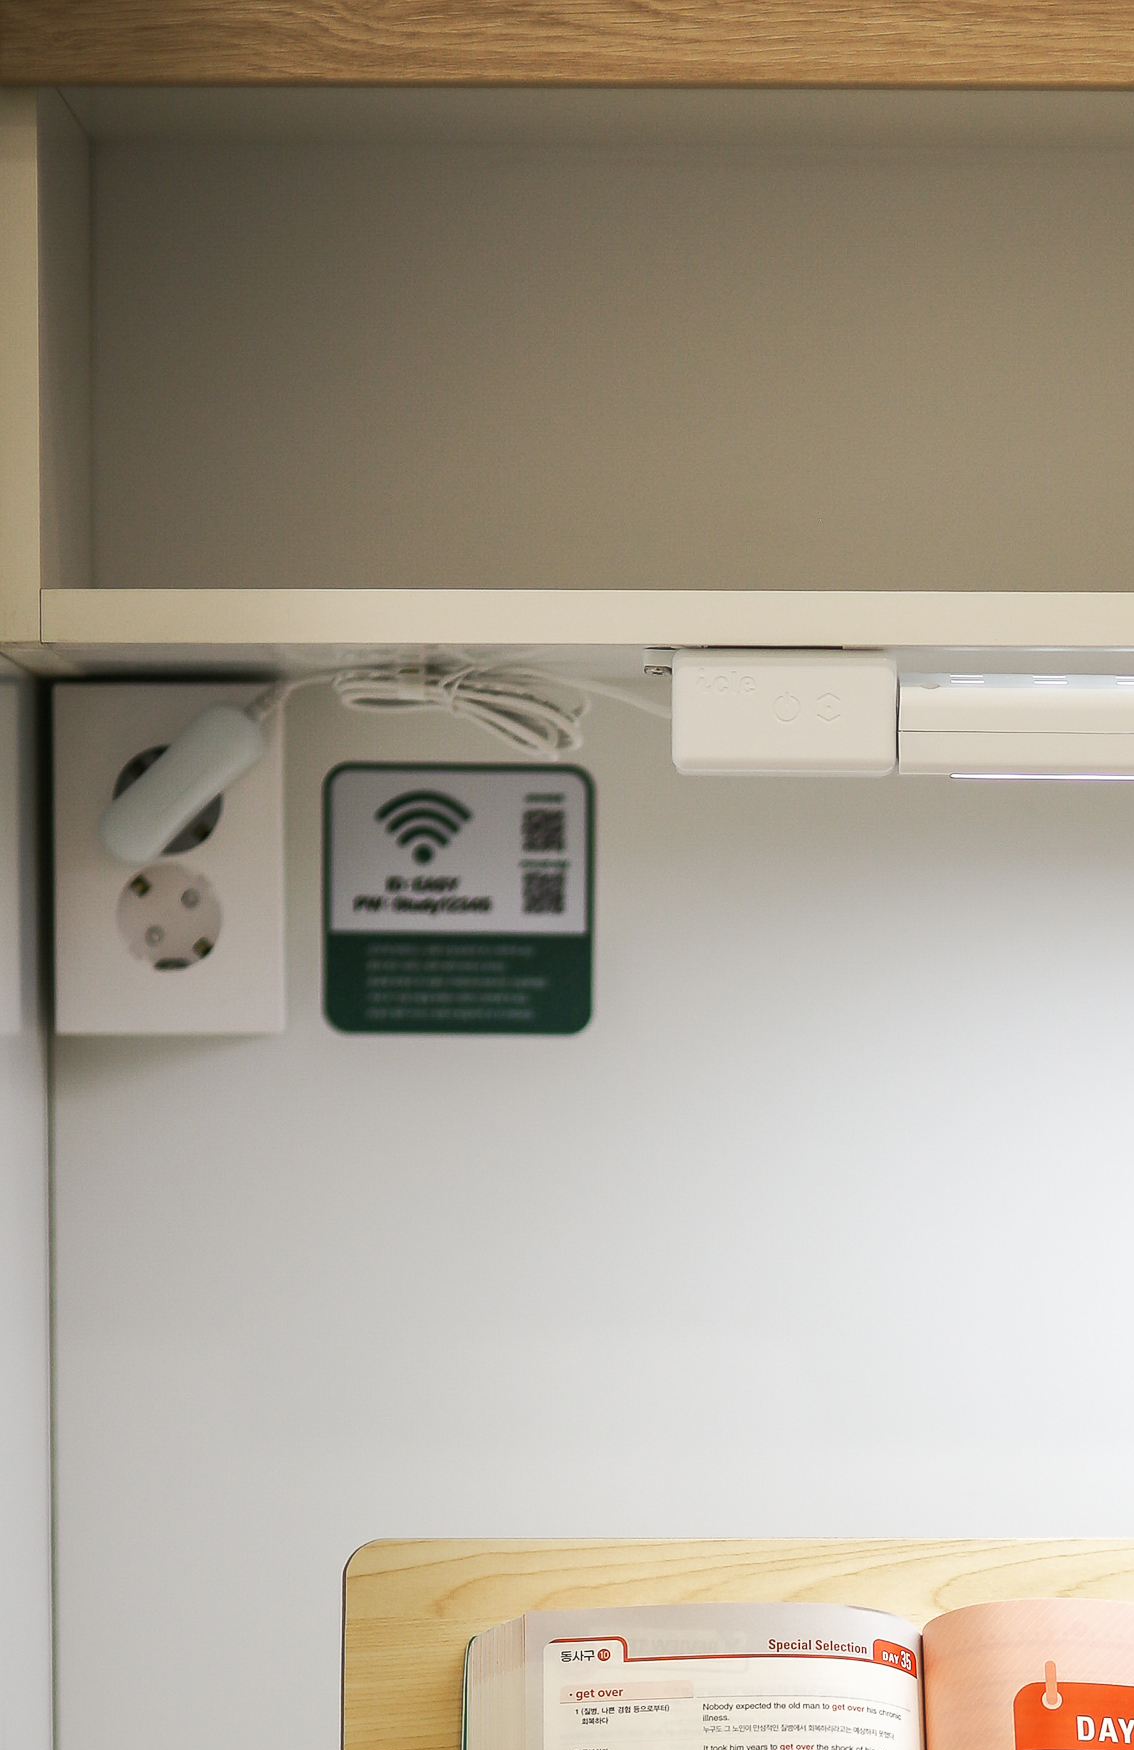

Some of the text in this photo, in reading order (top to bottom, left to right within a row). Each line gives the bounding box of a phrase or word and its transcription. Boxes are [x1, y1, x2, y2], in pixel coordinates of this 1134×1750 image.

[768, 1639, 868, 1654] Special Selection
[560, 1649, 610, 1663] 동사구 10
[882, 1650, 912, 1671] DAY 35
[576, 1689, 624, 1701] get over
[601, 1706, 615, 1715] 나쁜
[617, 1705, 631, 1714] 경험
[702, 1703, 733, 1711] Nobody
[735, 1702, 772, 1711] expected
[773, 1702, 786, 1710] the
[831, 1704, 845, 1712] get
[847, 1704, 865, 1712] over
[866, 1706, 877, 1715] his
[878, 1708, 902, 1721] chronic
[702, 1714, 730, 1722] illness.
[769, 1743, 778, 1750] to
